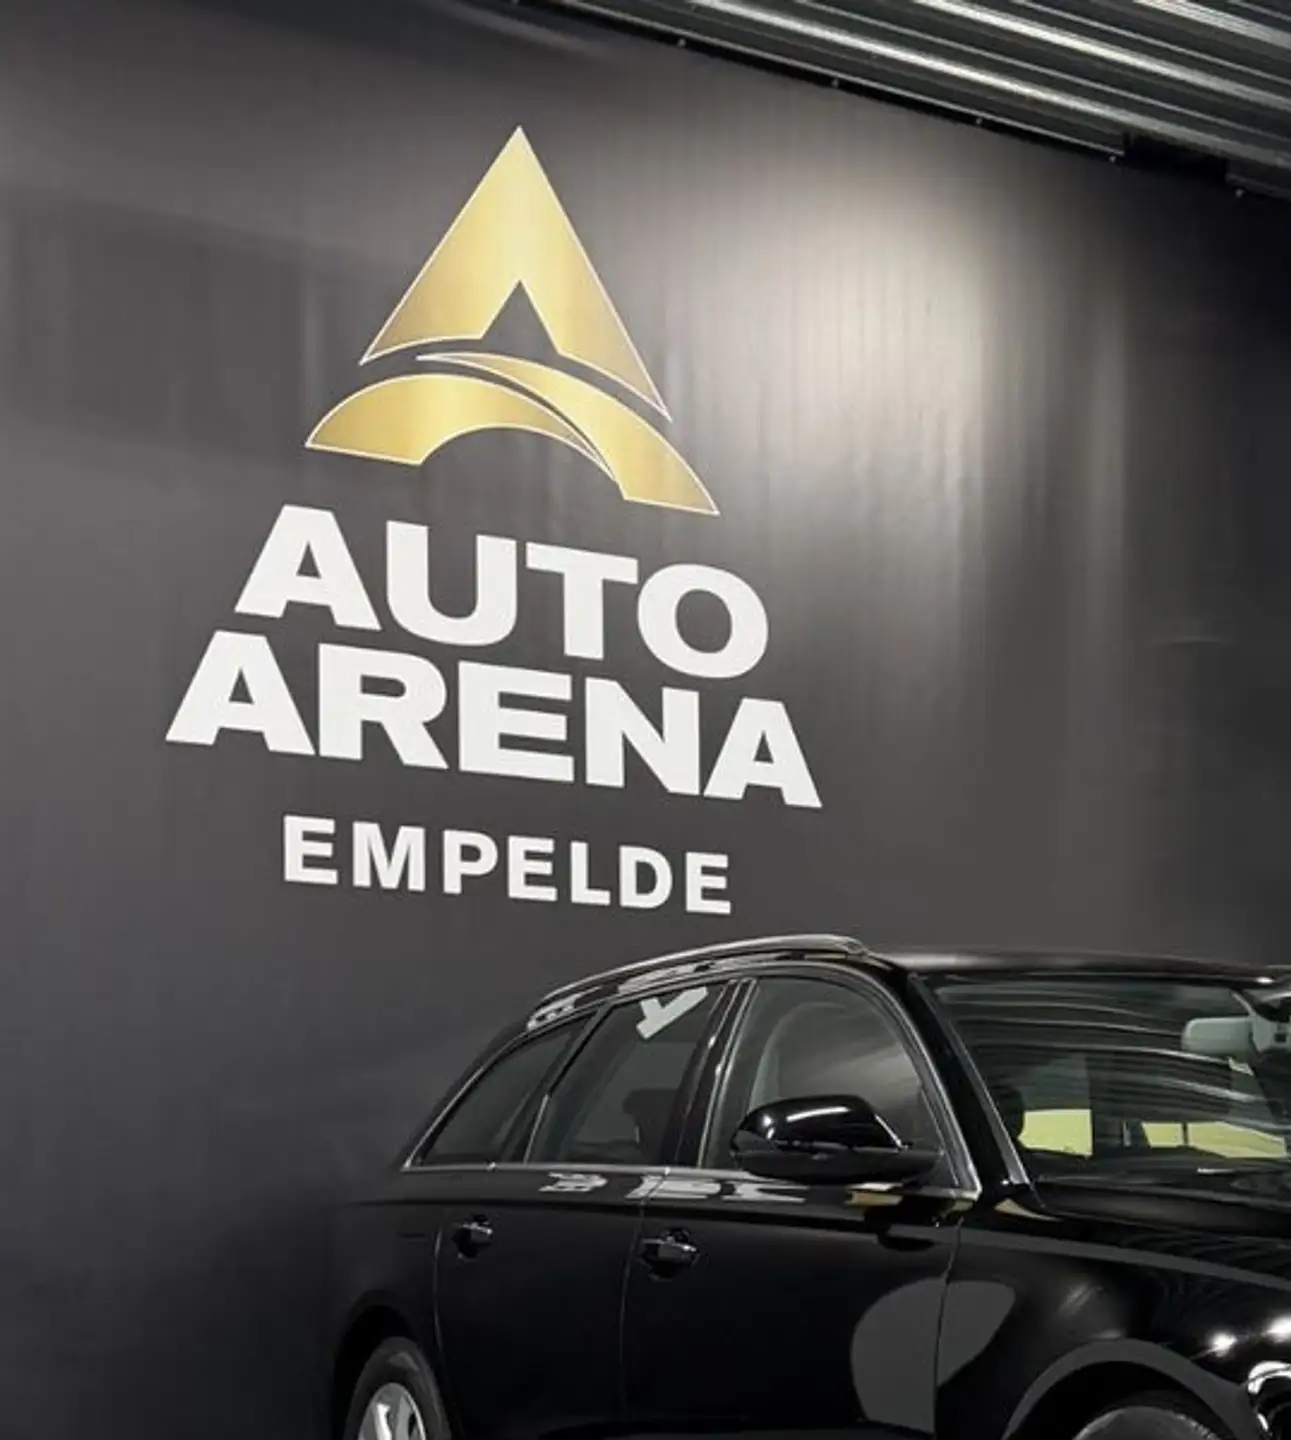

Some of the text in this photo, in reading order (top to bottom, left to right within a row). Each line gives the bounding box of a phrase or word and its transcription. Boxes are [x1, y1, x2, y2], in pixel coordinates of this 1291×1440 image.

[234, 504, 769, 679] AUTO
[165, 630, 822, 808] ARENA
[284, 815, 731, 914] EMPELDE
